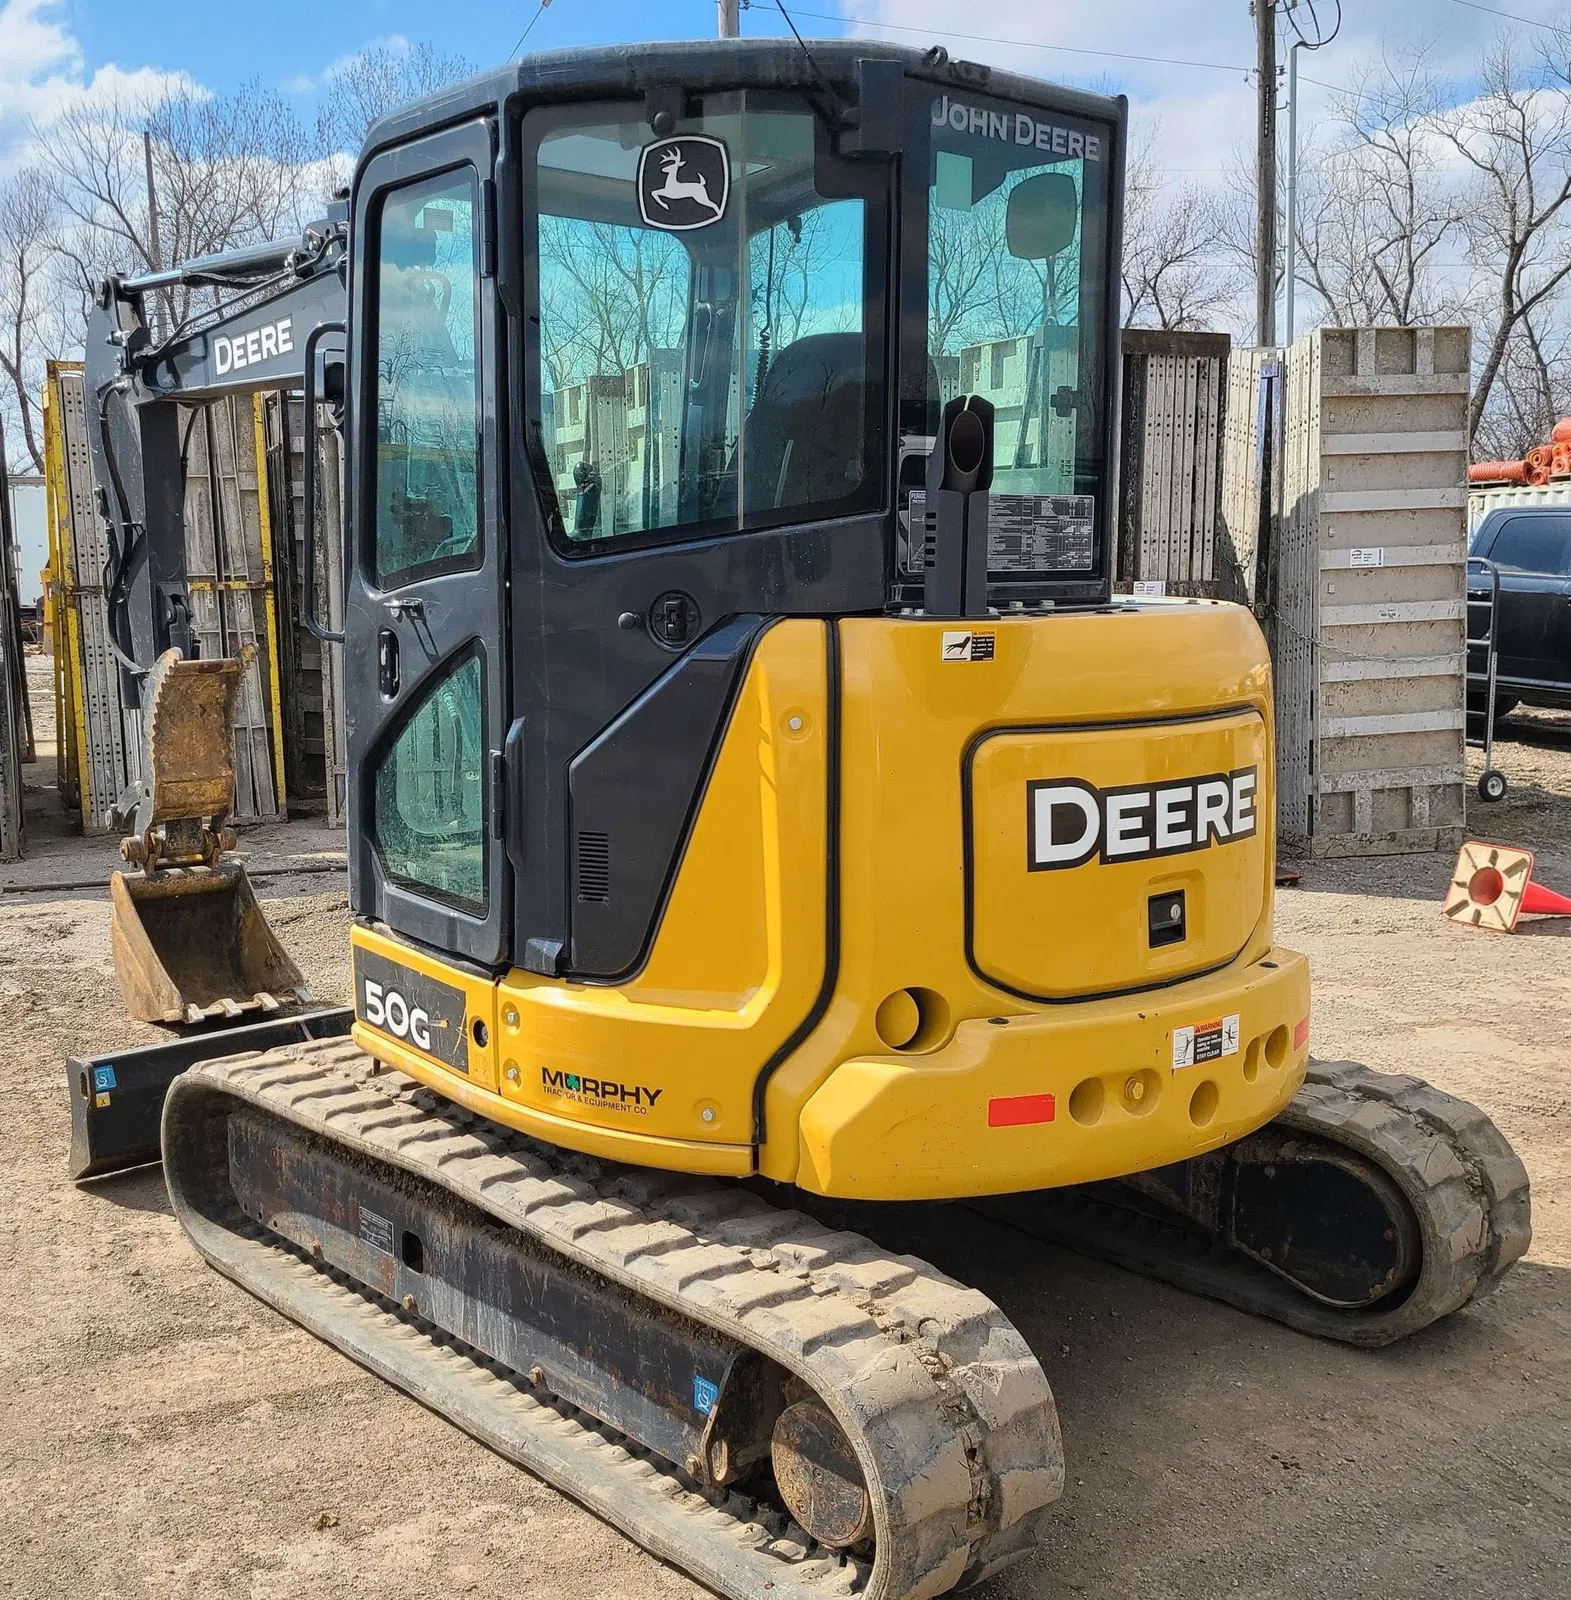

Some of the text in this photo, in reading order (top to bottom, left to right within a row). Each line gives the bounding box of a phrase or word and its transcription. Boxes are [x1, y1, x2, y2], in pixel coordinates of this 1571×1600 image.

[931, 95, 1100, 162] JOHN DEERE
[214, 318, 294, 376] DEERE
[1034, 773, 1256, 864] DEERE
[365, 979, 431, 1050] 50G
[1200, 1020, 1223, 1032] WARNING
[1196, 1049, 1220, 1060] STAY CLEAR
[542, 1066, 663, 1107] MURPHY
[542, 1085, 650, 1116] TRACOR & EQUIPMENT CO.
